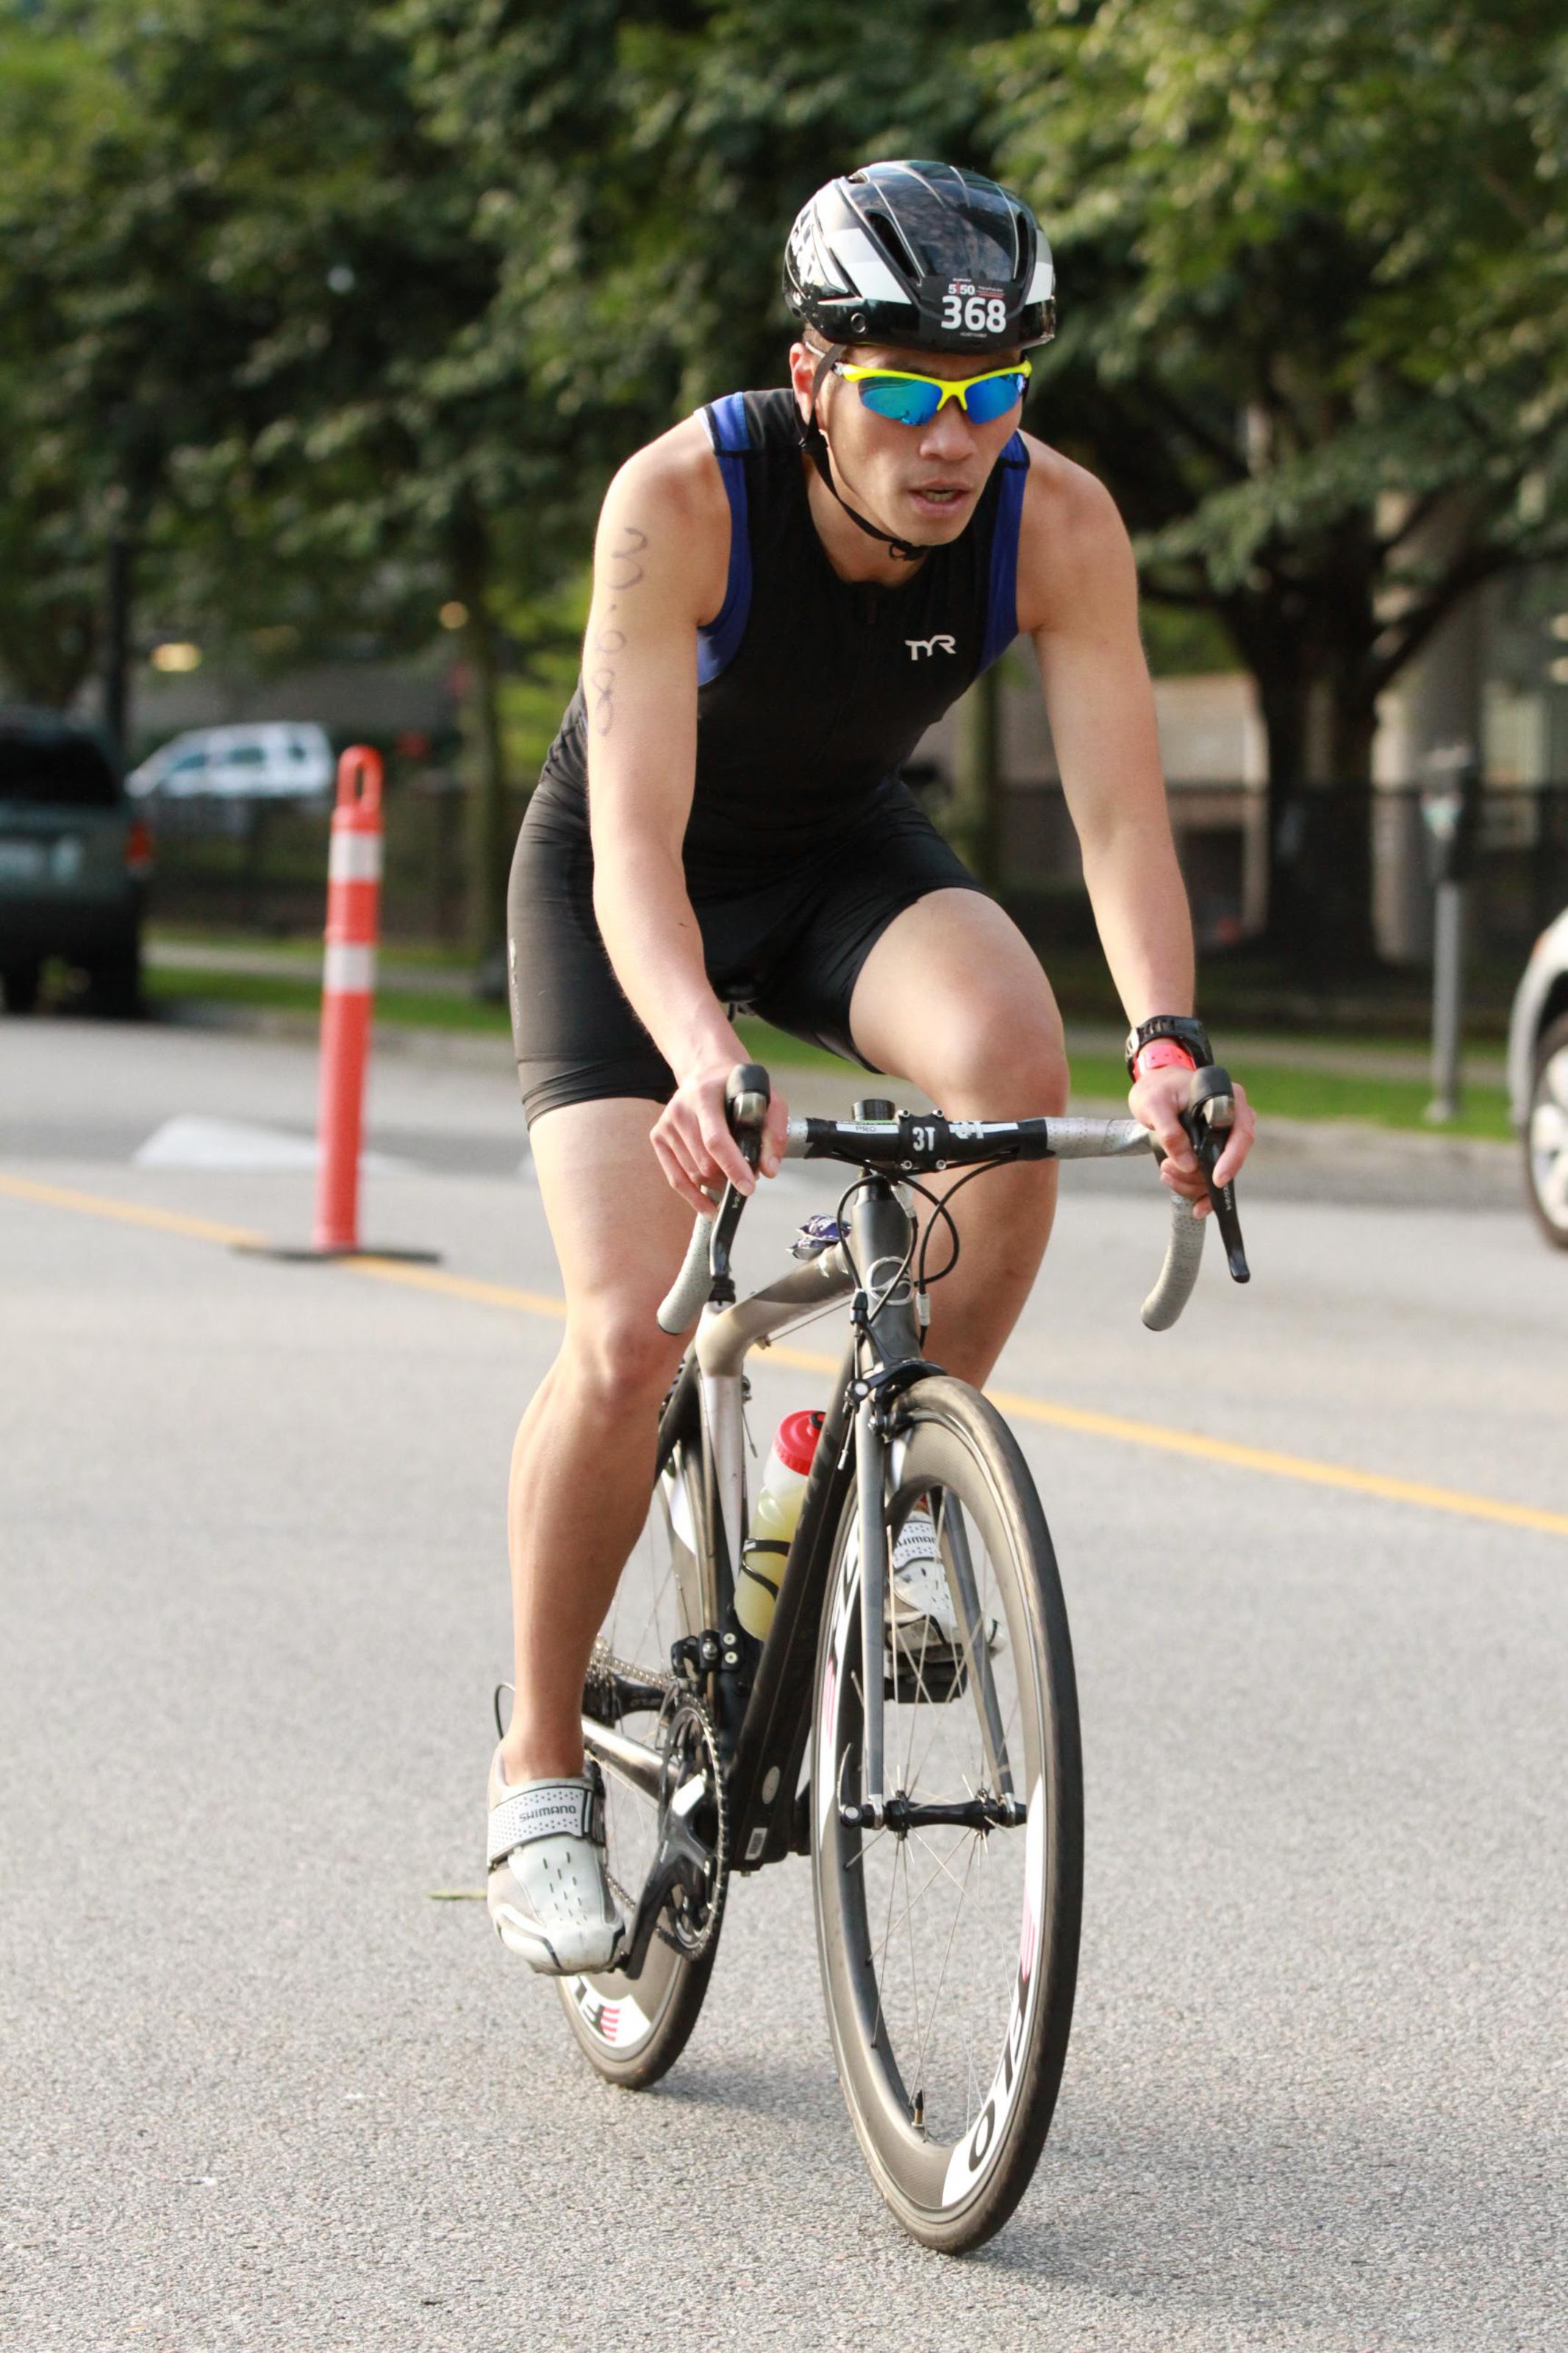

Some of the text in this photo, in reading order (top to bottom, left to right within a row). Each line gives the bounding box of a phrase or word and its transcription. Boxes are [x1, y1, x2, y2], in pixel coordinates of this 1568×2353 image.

[941, 296, 1006, 333] 368
[905, 635, 956, 660] TYR
[912, 1126, 936, 1151] 3T
[519, 1805, 576, 1823] SHIMANO
